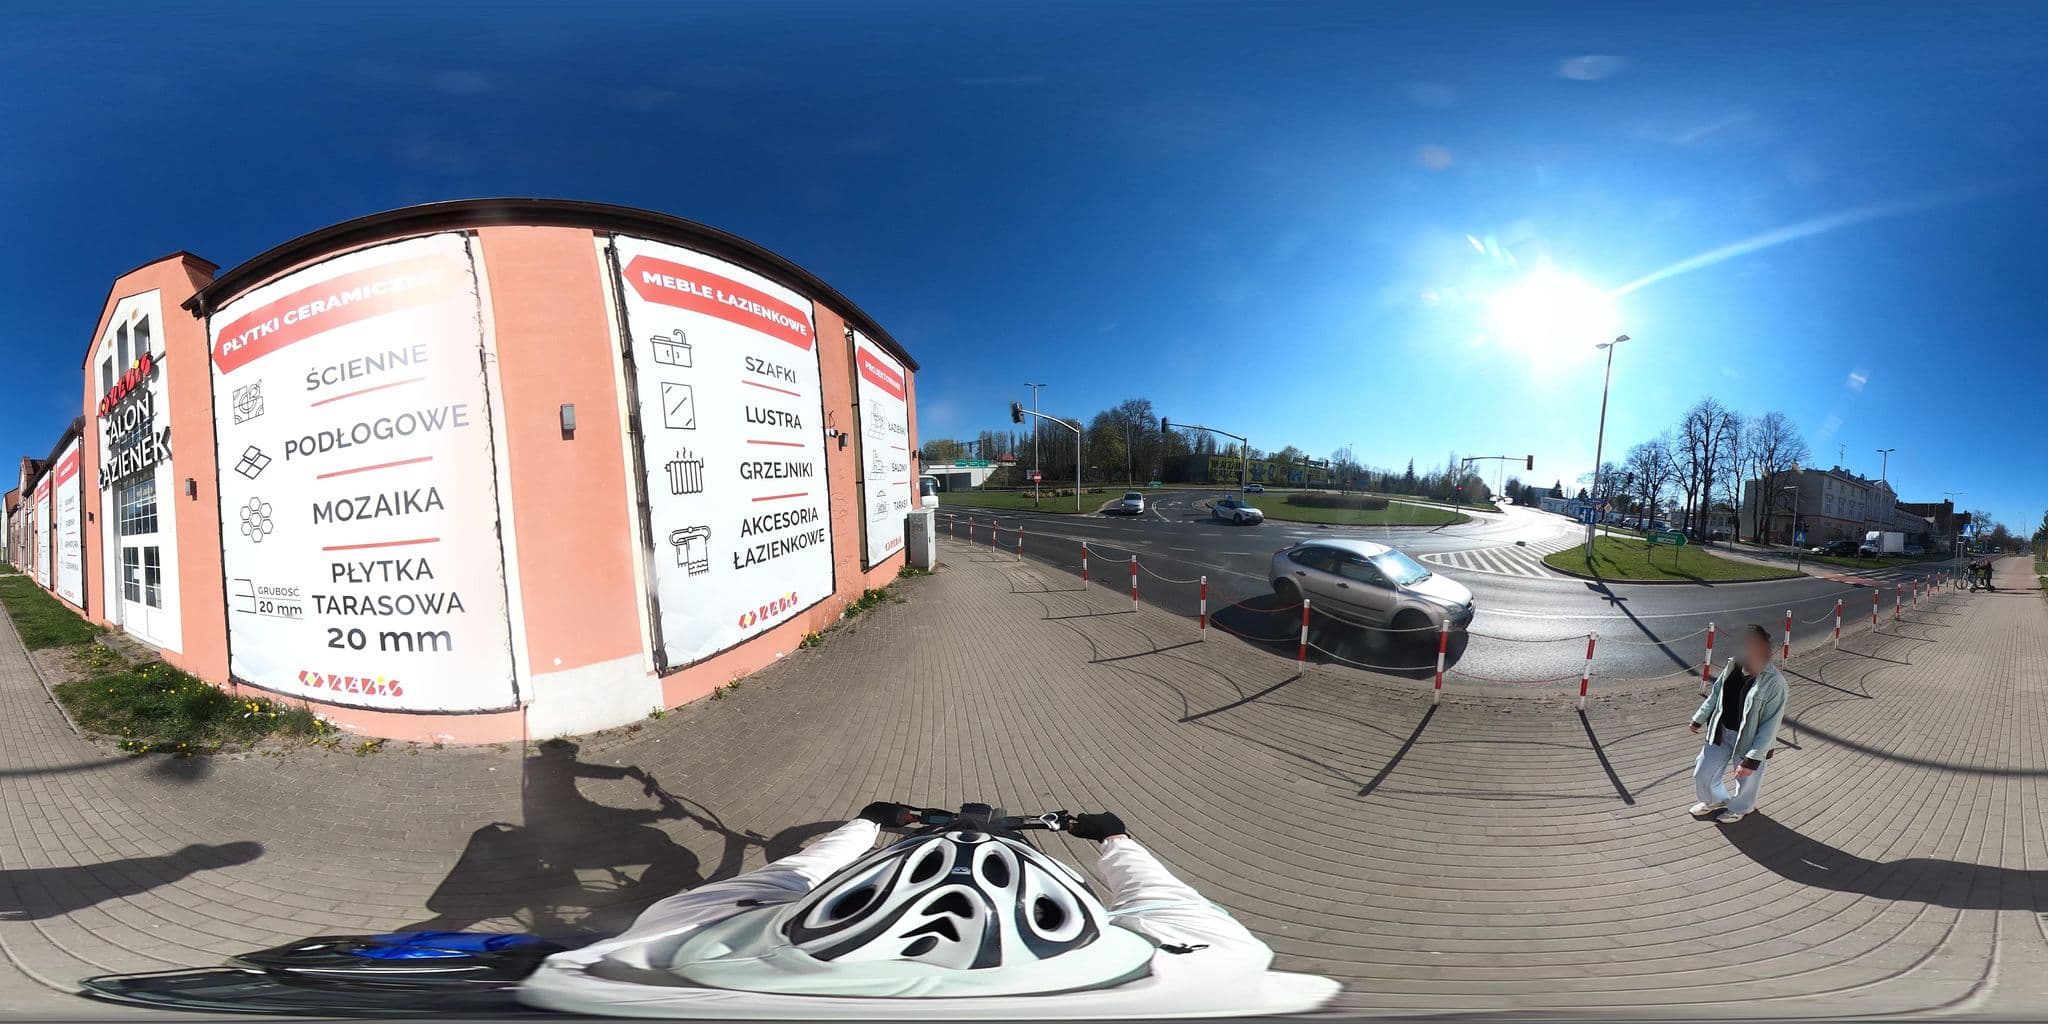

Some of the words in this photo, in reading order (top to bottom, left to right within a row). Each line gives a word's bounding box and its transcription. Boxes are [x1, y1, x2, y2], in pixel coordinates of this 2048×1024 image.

[641, 271, 713, 300] MEBLE
[716, 290, 807, 336] ŁAZIENKOWE
[223, 317, 280, 356] PŁYTKI
[306, 344, 428, 391] ŚCIENNE
[745, 356, 796, 384] SZAFKI
[745, 405, 802, 430] LUSTRA
[285, 404, 469, 461] PODŁOGOWE
[740, 461, 813, 480] GRZEJNIKI
[313, 487, 444, 524] MOZAIKA
[740, 507, 819, 538] AKCESORIA
[733, 528, 825, 570] ŁAZIENKOWE
[331, 558, 434, 583] PŁYTKA
[258, 586, 300, 597] GRUBOŚĆ
[312, 592, 465, 616] TARASOWA
[259, 601, 274, 613] 20
[277, 605, 302, 615] mm
[328, 627, 366, 650] 20
[380, 631, 452, 652] mm
